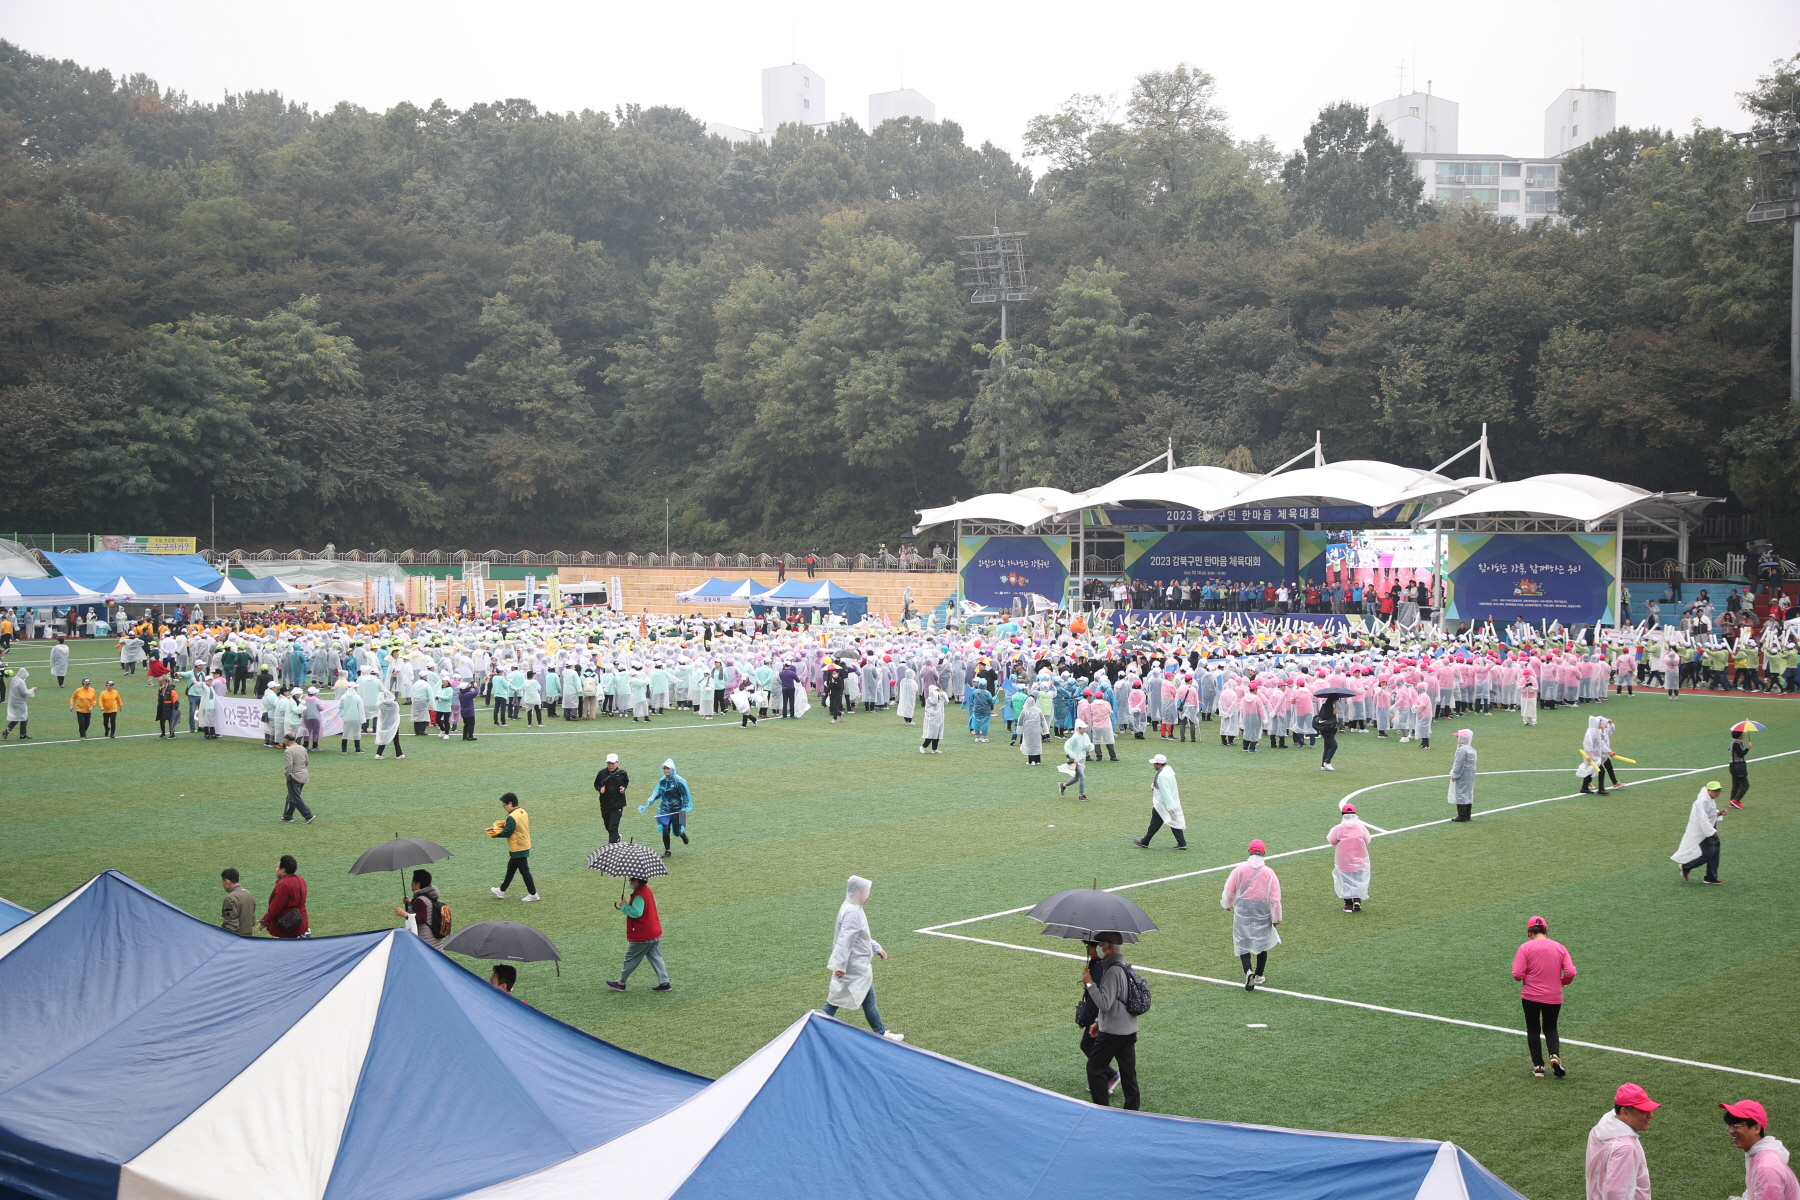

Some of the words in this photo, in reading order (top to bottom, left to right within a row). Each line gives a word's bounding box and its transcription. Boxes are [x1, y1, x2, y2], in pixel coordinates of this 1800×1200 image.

[1166, 510, 1192, 520] 2023
[1198, 510, 1236, 520] 강구민
[1242, 509, 1272, 520] 한마음
[1278, 508, 1320, 520] 체육대회
[154, 543, 189, 551] 누구인가?
[1007, 559, 1029, 568] 하나되는
[1031, 559, 1050, 569] 강북구민
[1150, 556, 1170, 566] 2023
[1172, 556, 1202, 566] 강북구민
[1204, 556, 1227, 566] 한마음
[1229, 556, 1261, 567] 체육대회
[1511, 563, 1526, 575] 강북,
[1530, 563, 1564, 574] 함께하는
[1567, 564, 1582, 574] 우리
